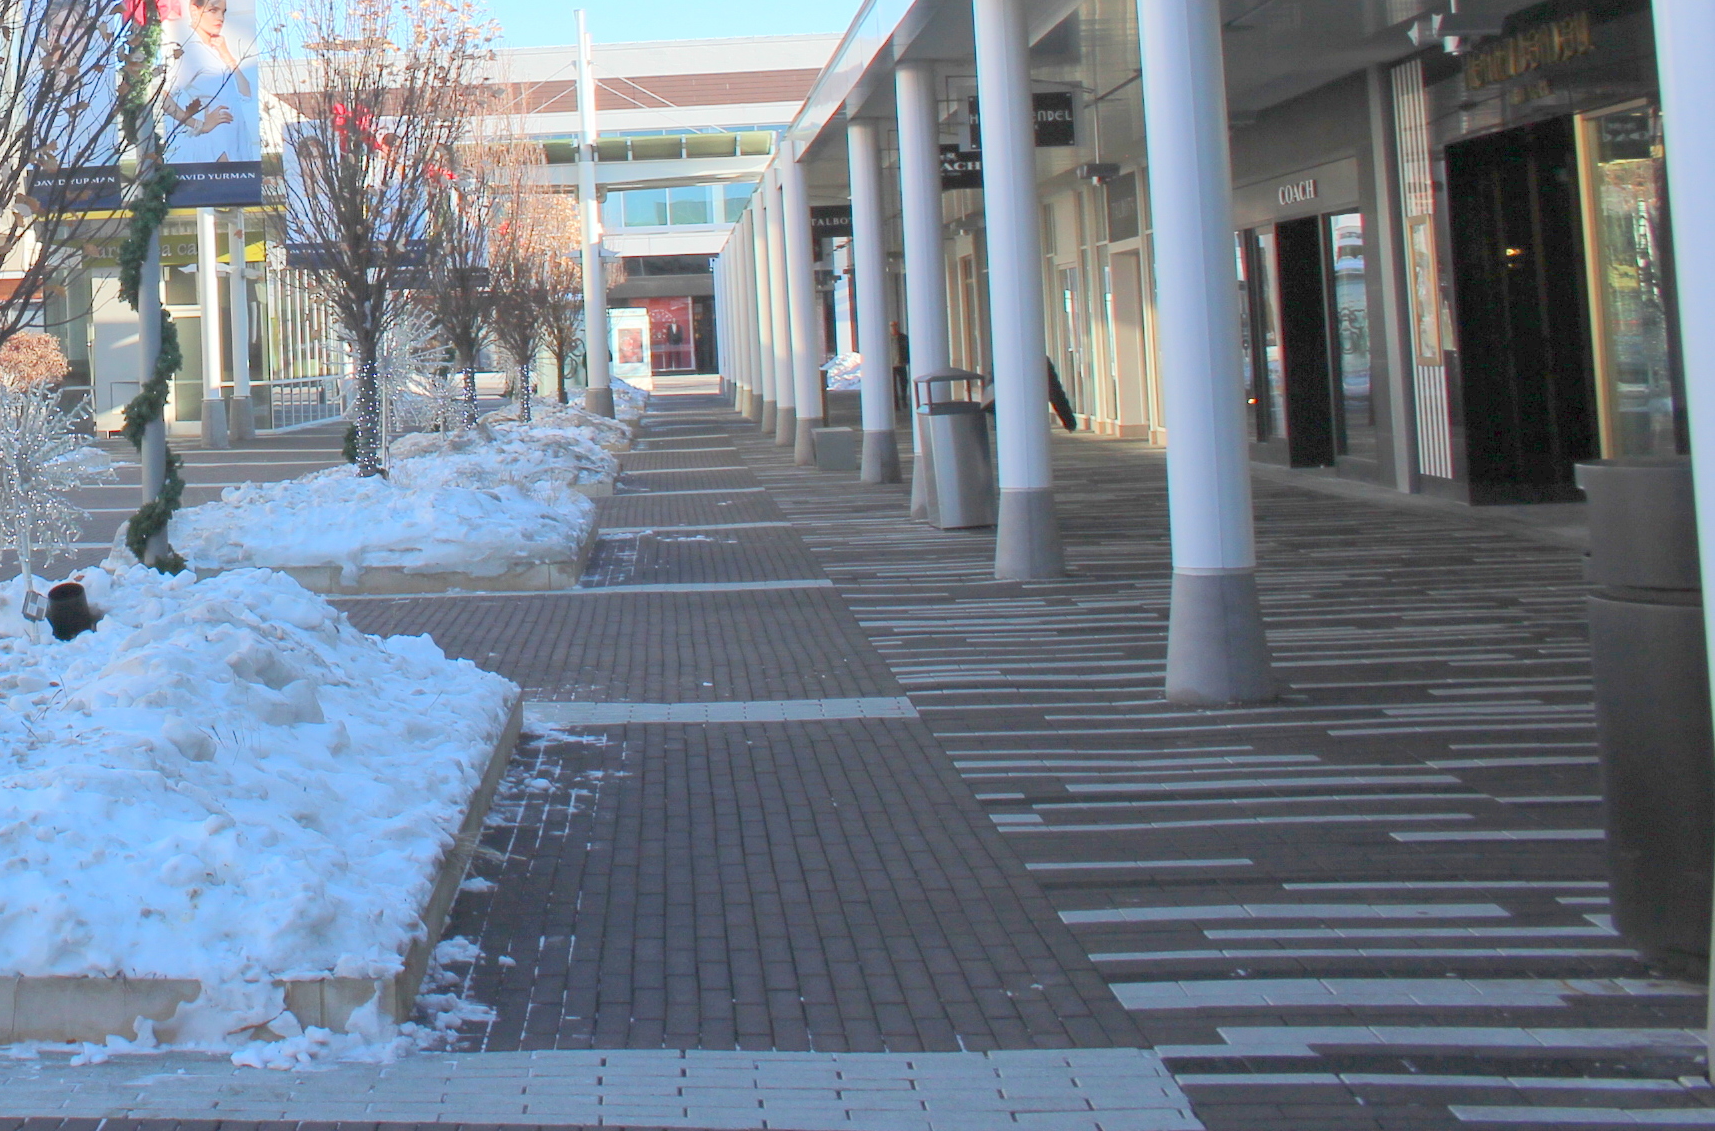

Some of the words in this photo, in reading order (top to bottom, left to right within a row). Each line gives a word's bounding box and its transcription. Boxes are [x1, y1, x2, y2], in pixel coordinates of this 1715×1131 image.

[175, 173, 205, 181] AVID
[208, 172, 256, 180] YURMAN
[1279, 179, 1315, 205] COACH
[811, 218, 849, 226] TALBO
